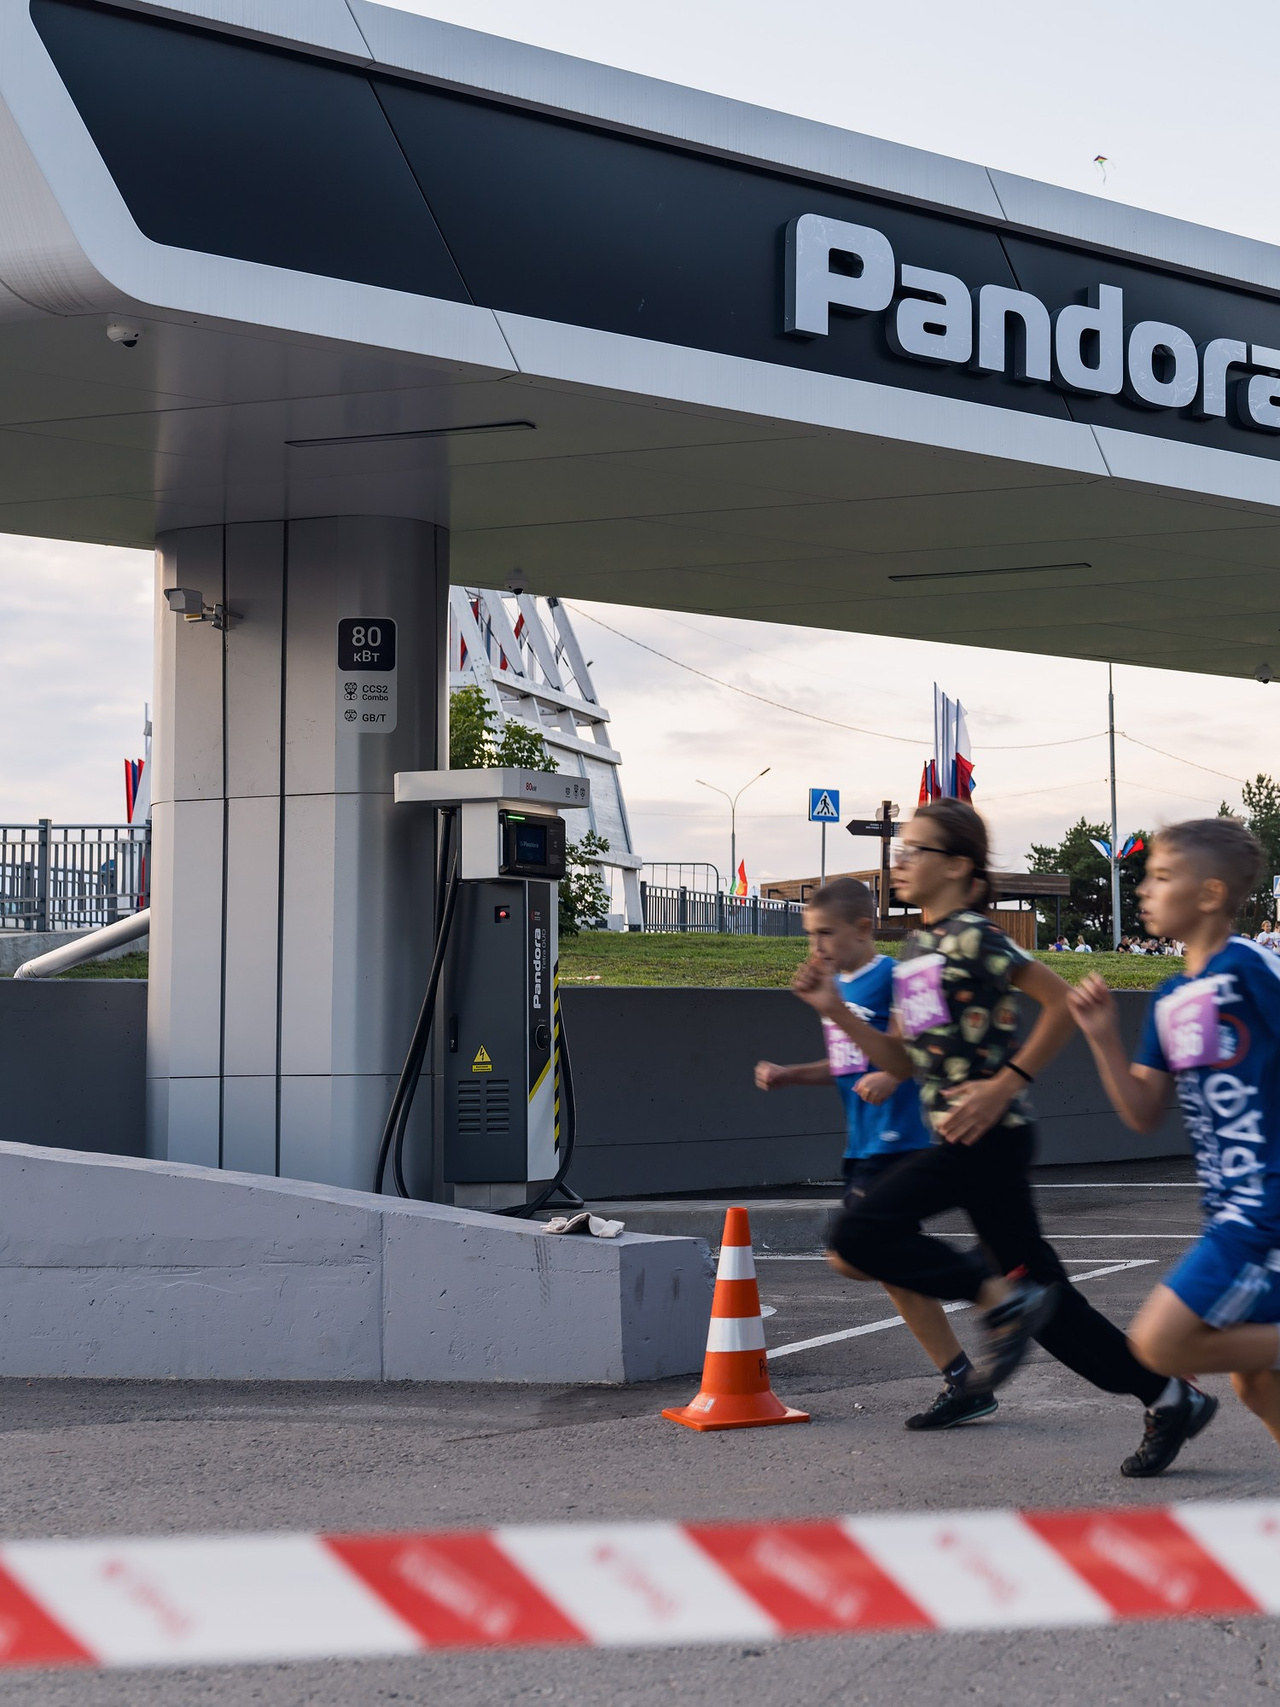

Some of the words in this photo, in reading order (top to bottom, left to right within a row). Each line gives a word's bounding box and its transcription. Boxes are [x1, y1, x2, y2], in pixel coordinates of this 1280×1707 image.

[351, 626, 382, 647] 80
[353, 650, 380, 662] кВт
[362, 685, 388, 694] CCS2
[362, 713, 387, 723] GB/T
[533, 928, 541, 1009] Pandora
